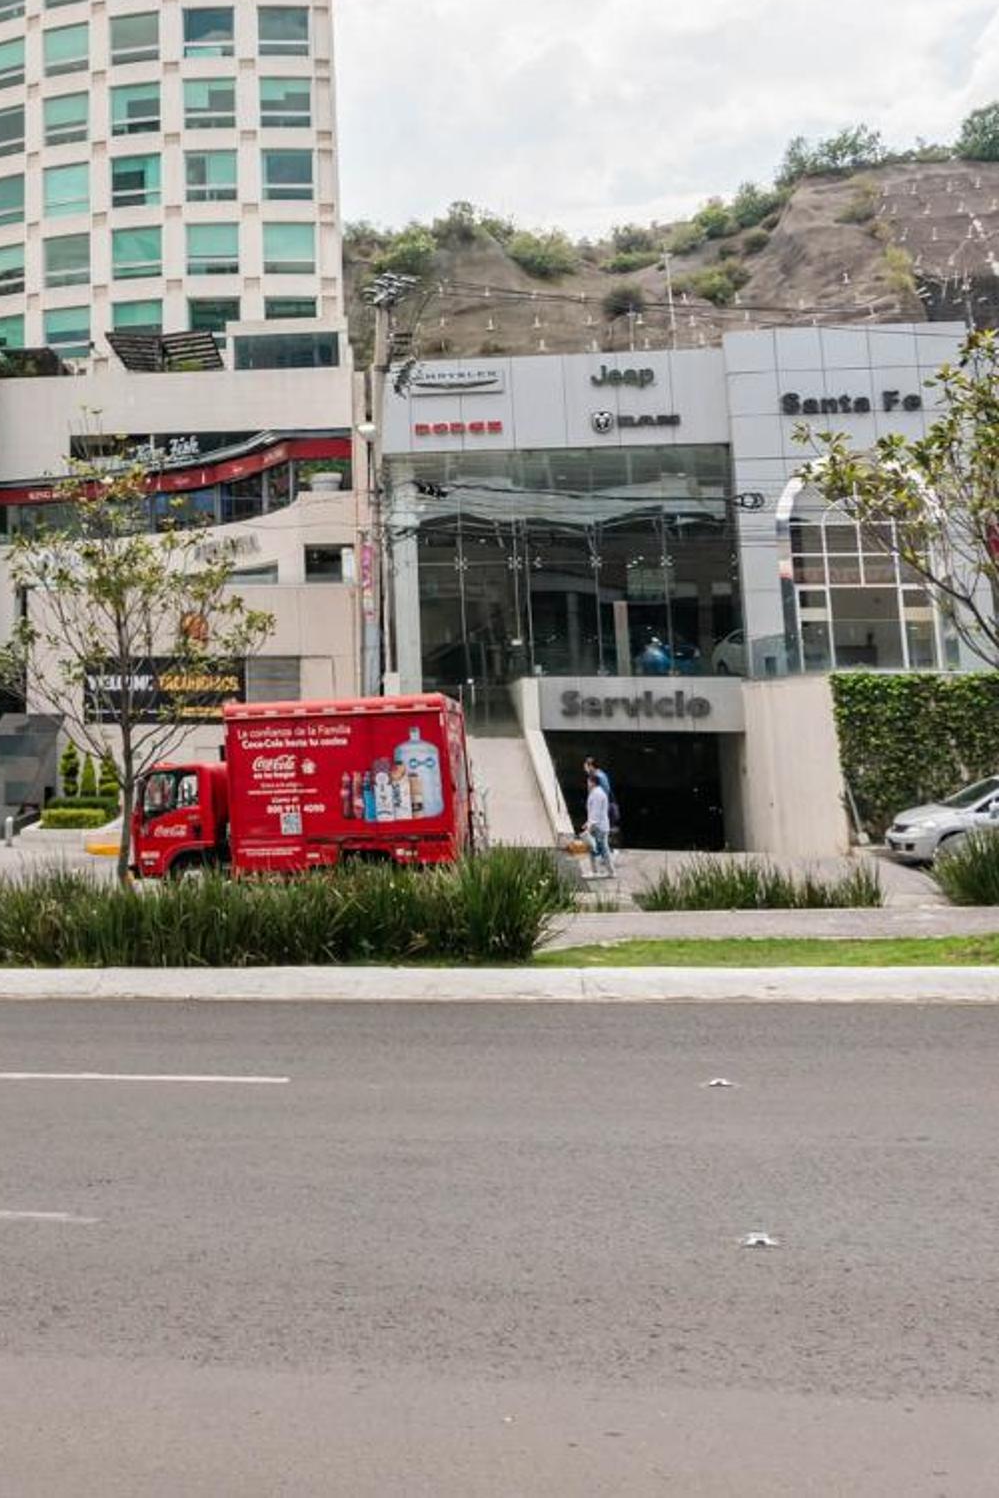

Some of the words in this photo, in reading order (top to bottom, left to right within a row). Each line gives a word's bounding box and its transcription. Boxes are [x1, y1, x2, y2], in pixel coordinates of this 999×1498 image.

[590, 366, 655, 388] Jeep
[782, 392, 870, 415] Santa
[882, 390, 922, 412] Fe
[414, 420, 503, 436] DODGE
[561, 690, 711, 718] Servicio
